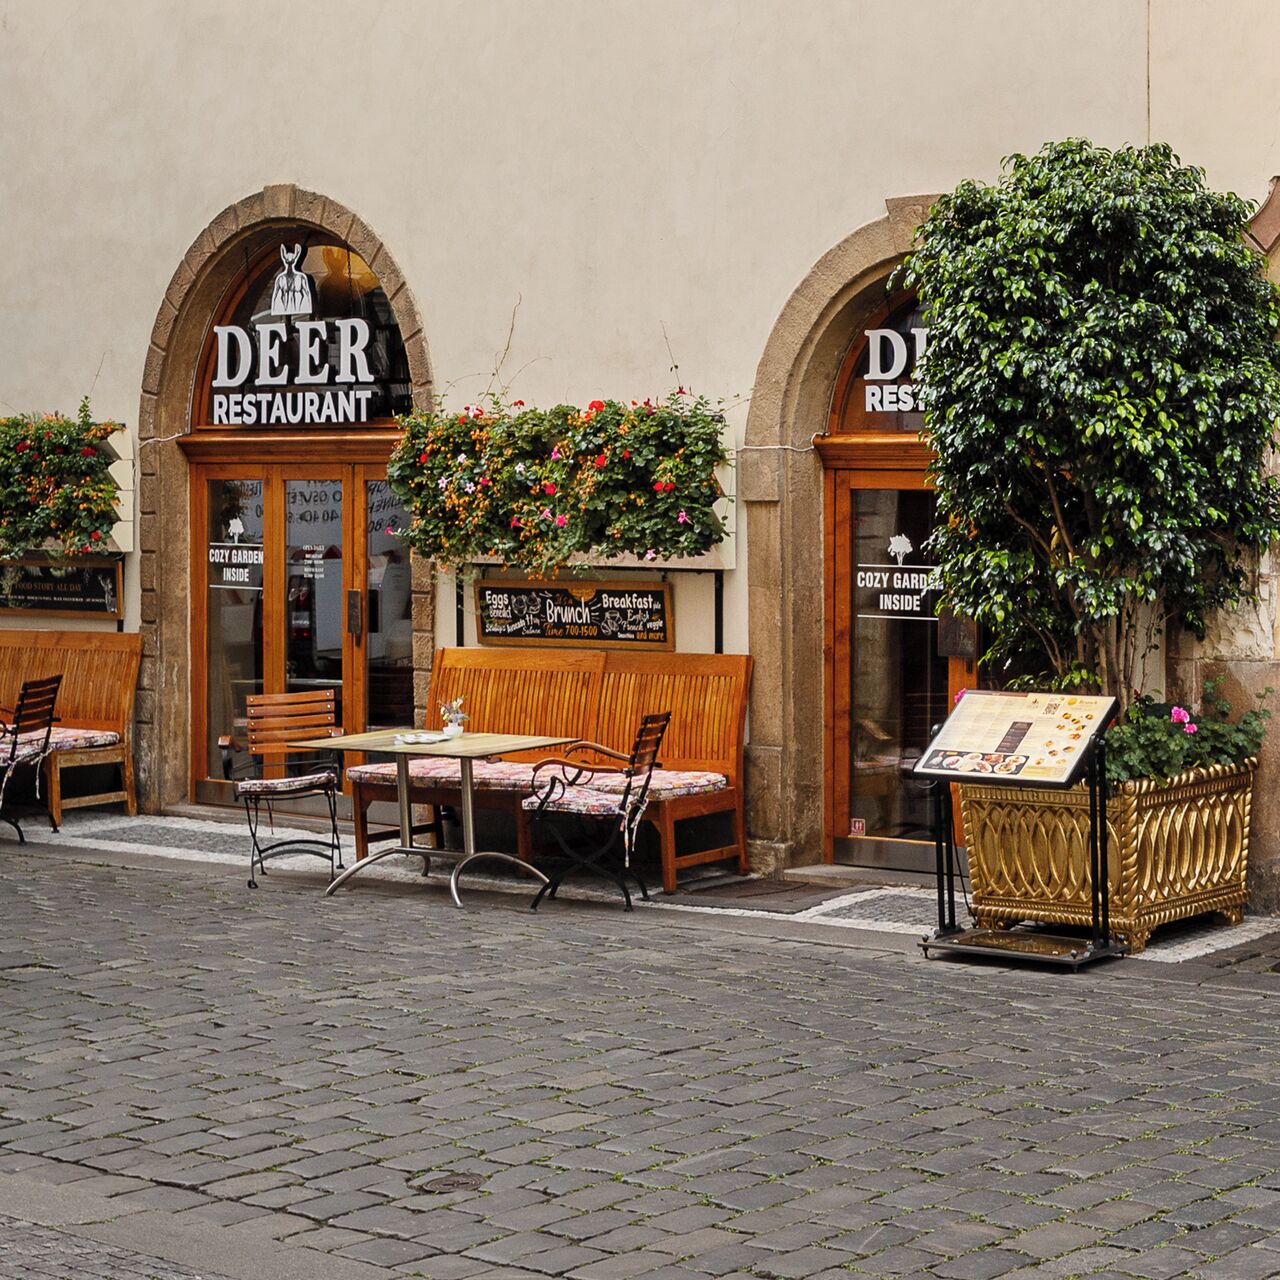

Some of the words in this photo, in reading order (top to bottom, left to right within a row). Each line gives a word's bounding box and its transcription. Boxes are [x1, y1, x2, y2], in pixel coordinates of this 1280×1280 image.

[212, 318, 374, 388] DEER
[213, 390, 372, 425] RESTAURANT
[209, 550, 230, 563] COZY
[232, 550, 264, 564] GARDEN
[223, 568, 249, 582] INSIDE
[857, 571, 889, 588] COZY
[485, 591, 509, 608] Eggs
[601, 593, 653, 609] Breakfast
[880, 594, 921, 611] INSIDE
[546, 597, 591, 624] Brunch
[636, 631, 647, 640] and
[649, 632, 664, 640] more
